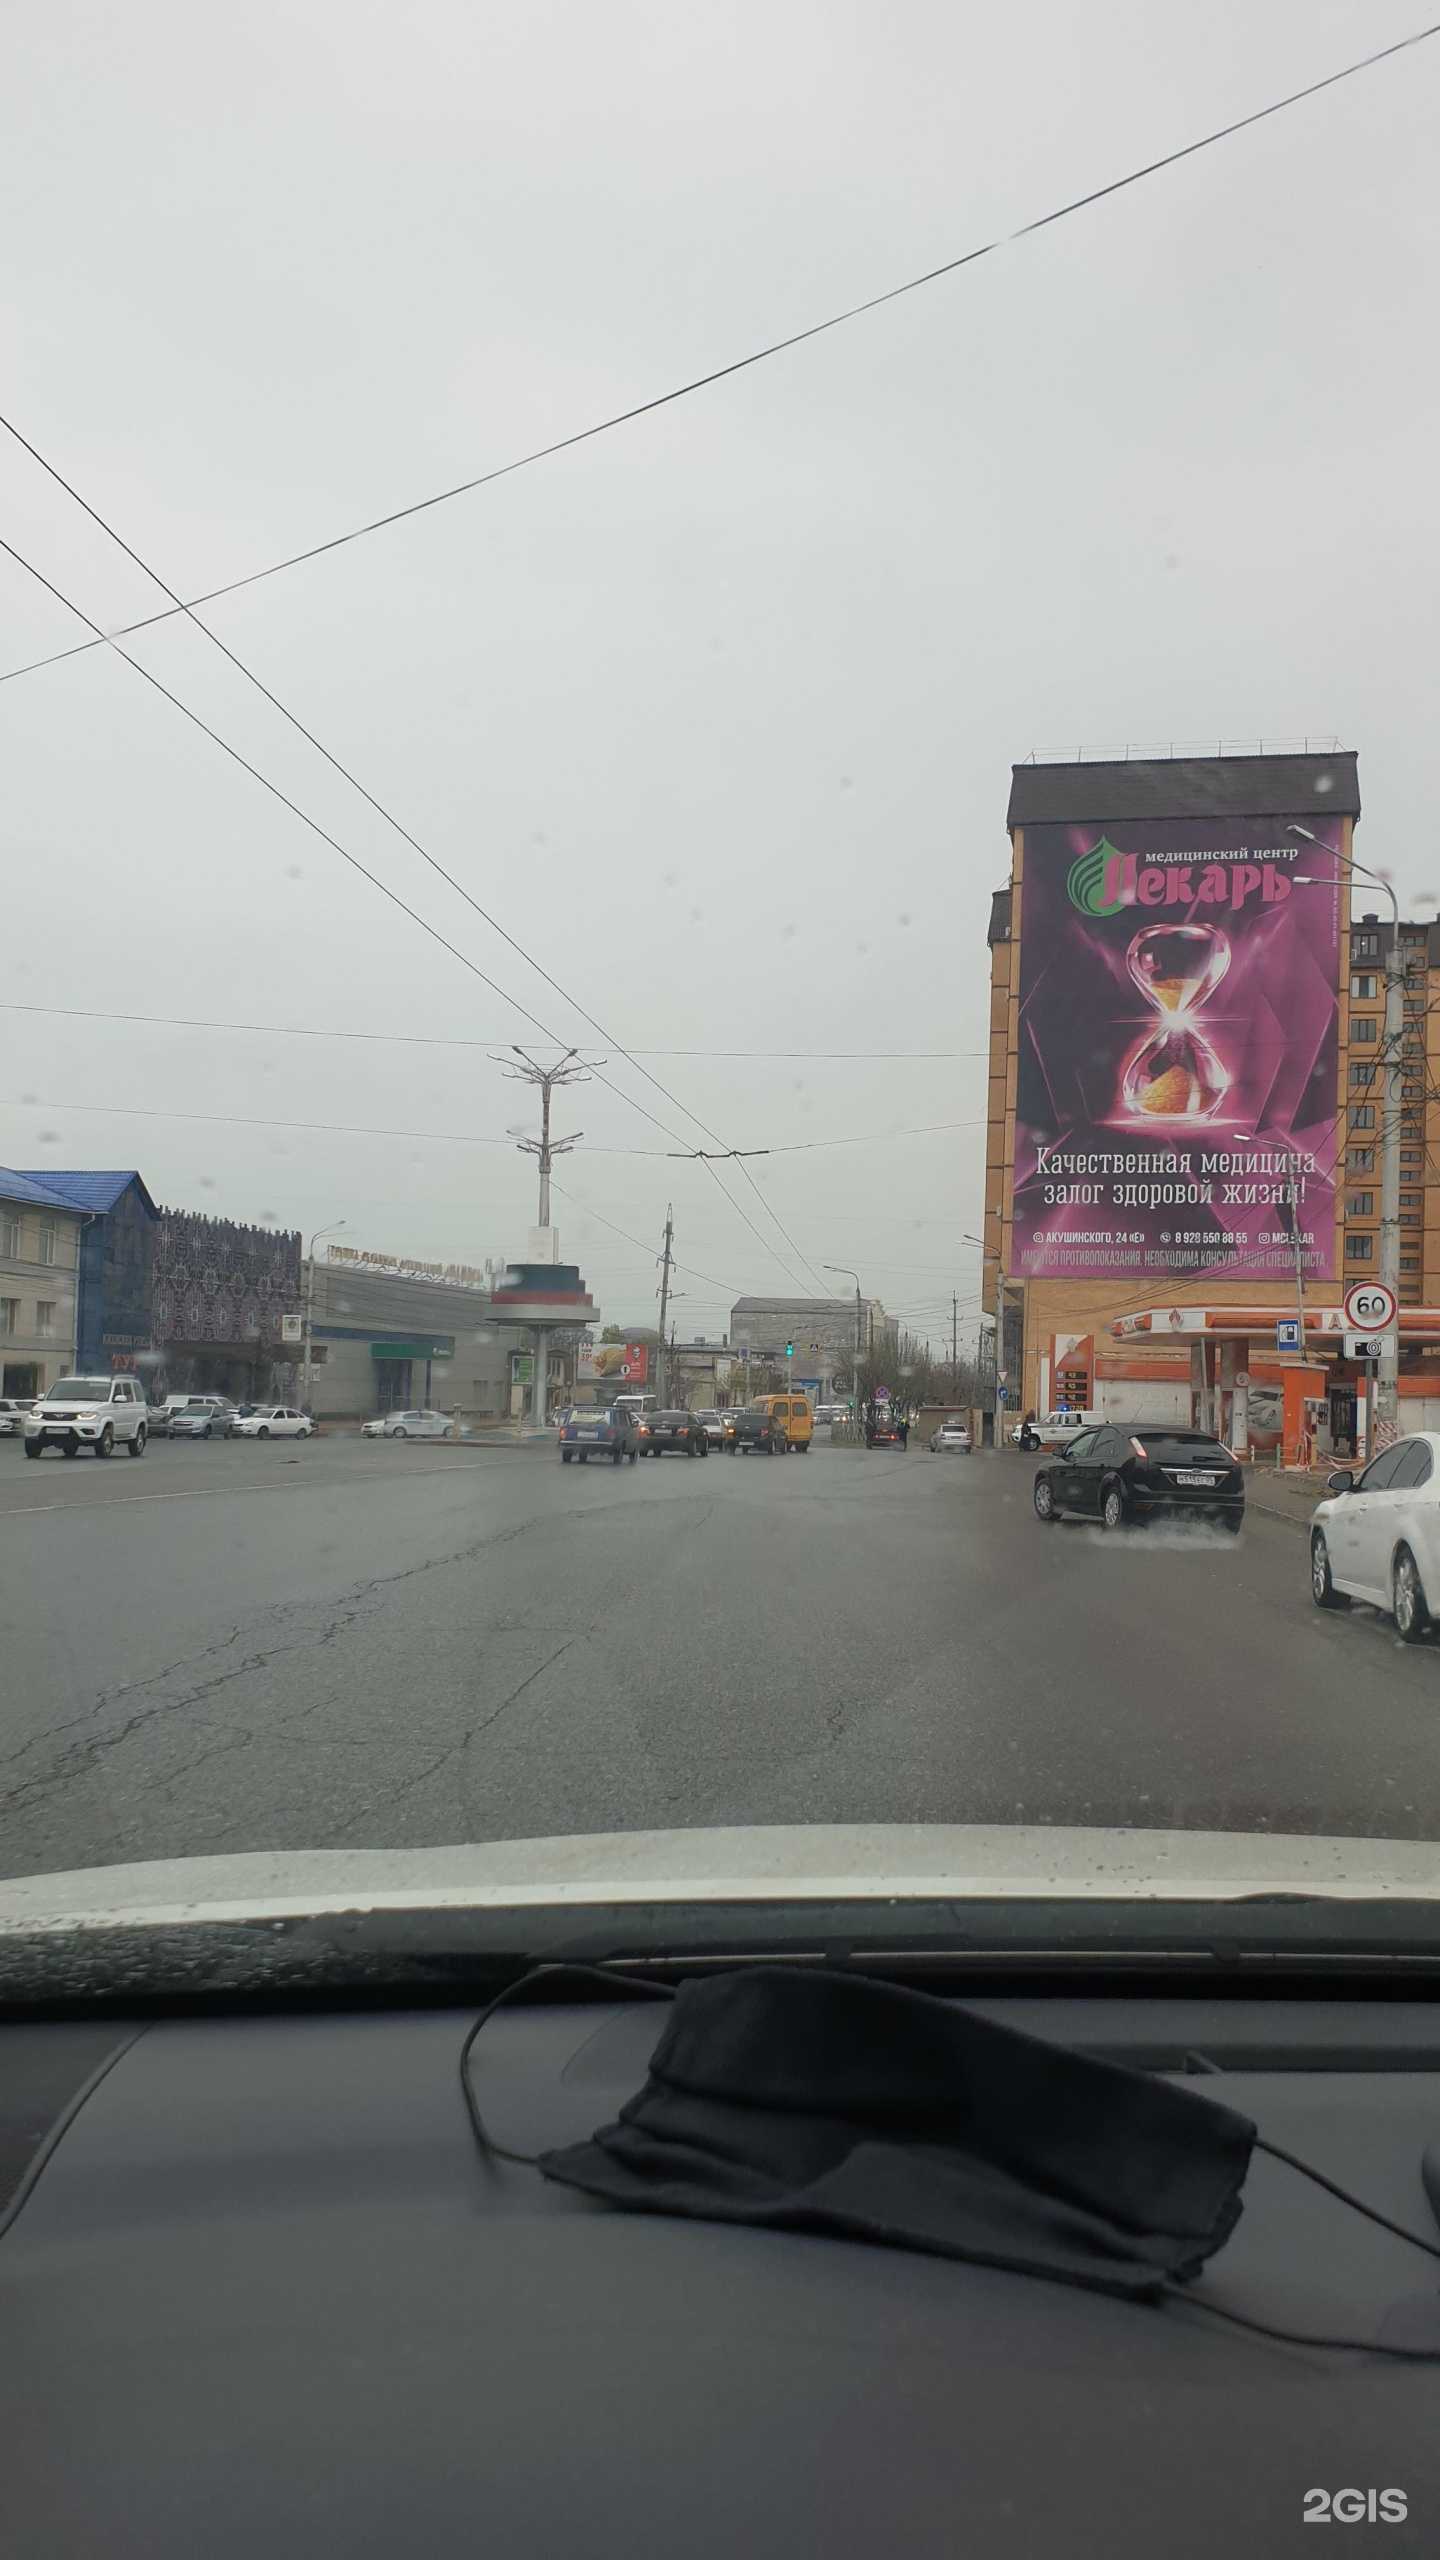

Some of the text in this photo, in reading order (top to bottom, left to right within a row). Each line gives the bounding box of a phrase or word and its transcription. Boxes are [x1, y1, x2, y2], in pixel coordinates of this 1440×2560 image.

[1145, 848, 1298, 863] медицинский центр
[1097, 852, 1292, 911] Лекарь
[1036, 1147, 1316, 1176] Качественная медицина
[1044, 1176, 1305, 1209] залог здоровой жизни!
[1046, 1232, 1114, 1245] АКУШИНСКОГО,
[1116, 1232, 1127, 1244] 24
[1235, 1232, 1248, 1244] 55
[1145, 1250, 1198, 1268] НЕОБХОДИМА
[1357, 1296, 1385, 1317] 60
